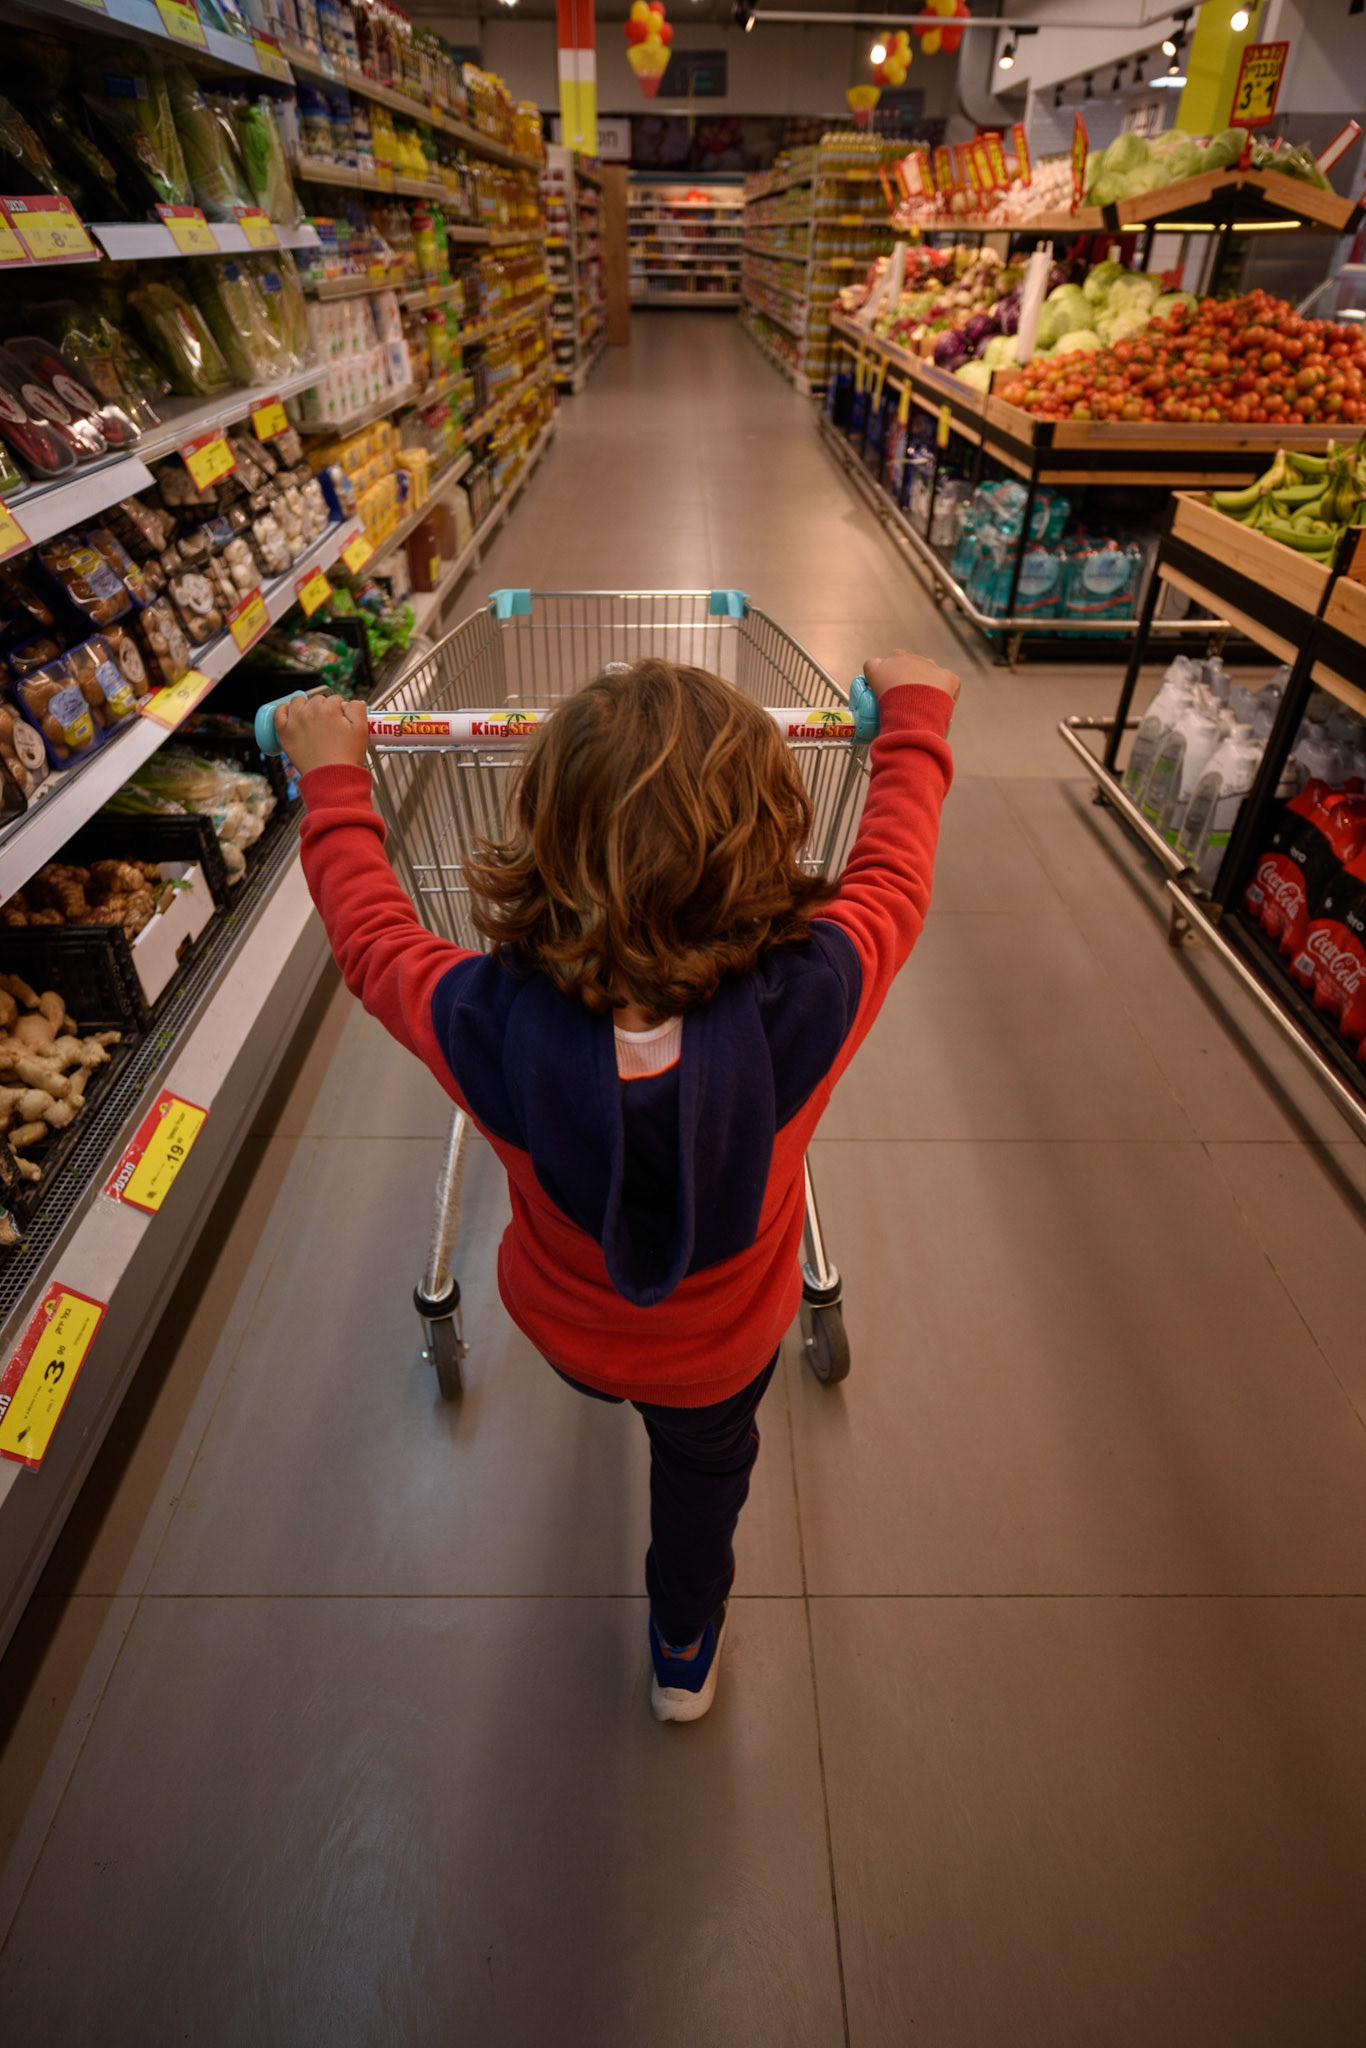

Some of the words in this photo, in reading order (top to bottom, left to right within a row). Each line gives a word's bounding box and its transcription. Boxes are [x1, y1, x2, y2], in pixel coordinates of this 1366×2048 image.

[1240, 82, 1253, 110] 3
[1264, 80, 1276, 109] 1
[166, 1144, 184, 1162] 19
[44, 1359, 65, 1385] 3
